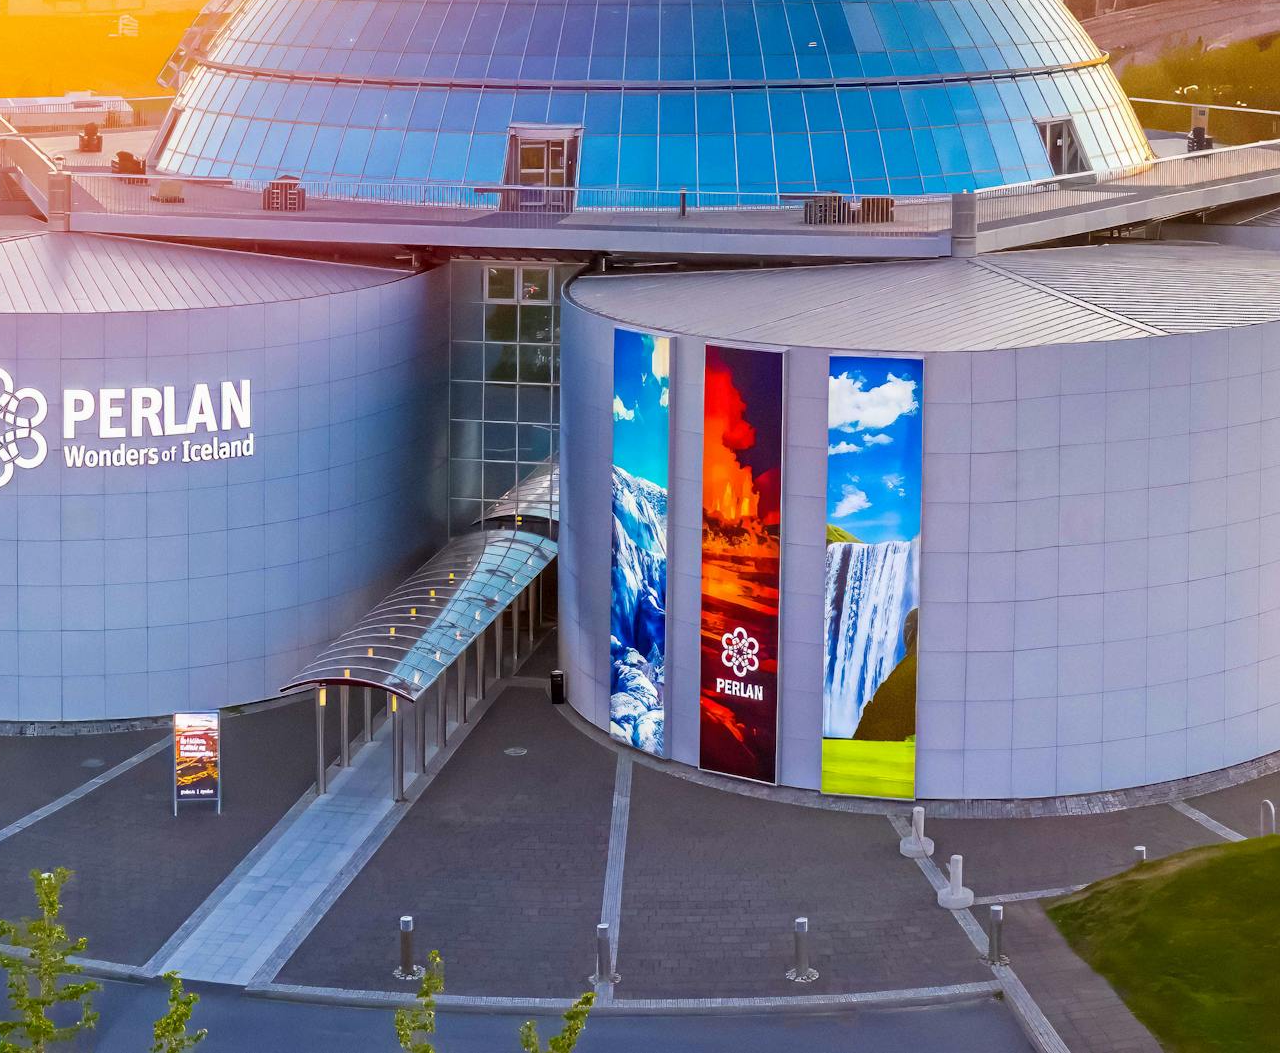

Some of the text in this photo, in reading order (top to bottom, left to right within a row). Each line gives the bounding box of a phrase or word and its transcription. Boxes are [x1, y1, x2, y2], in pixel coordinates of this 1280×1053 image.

[63, 380, 252, 439] PERLAN
[64, 433, 254, 468] Wonders of Iceland
[716, 678, 763, 701] PERLAN
